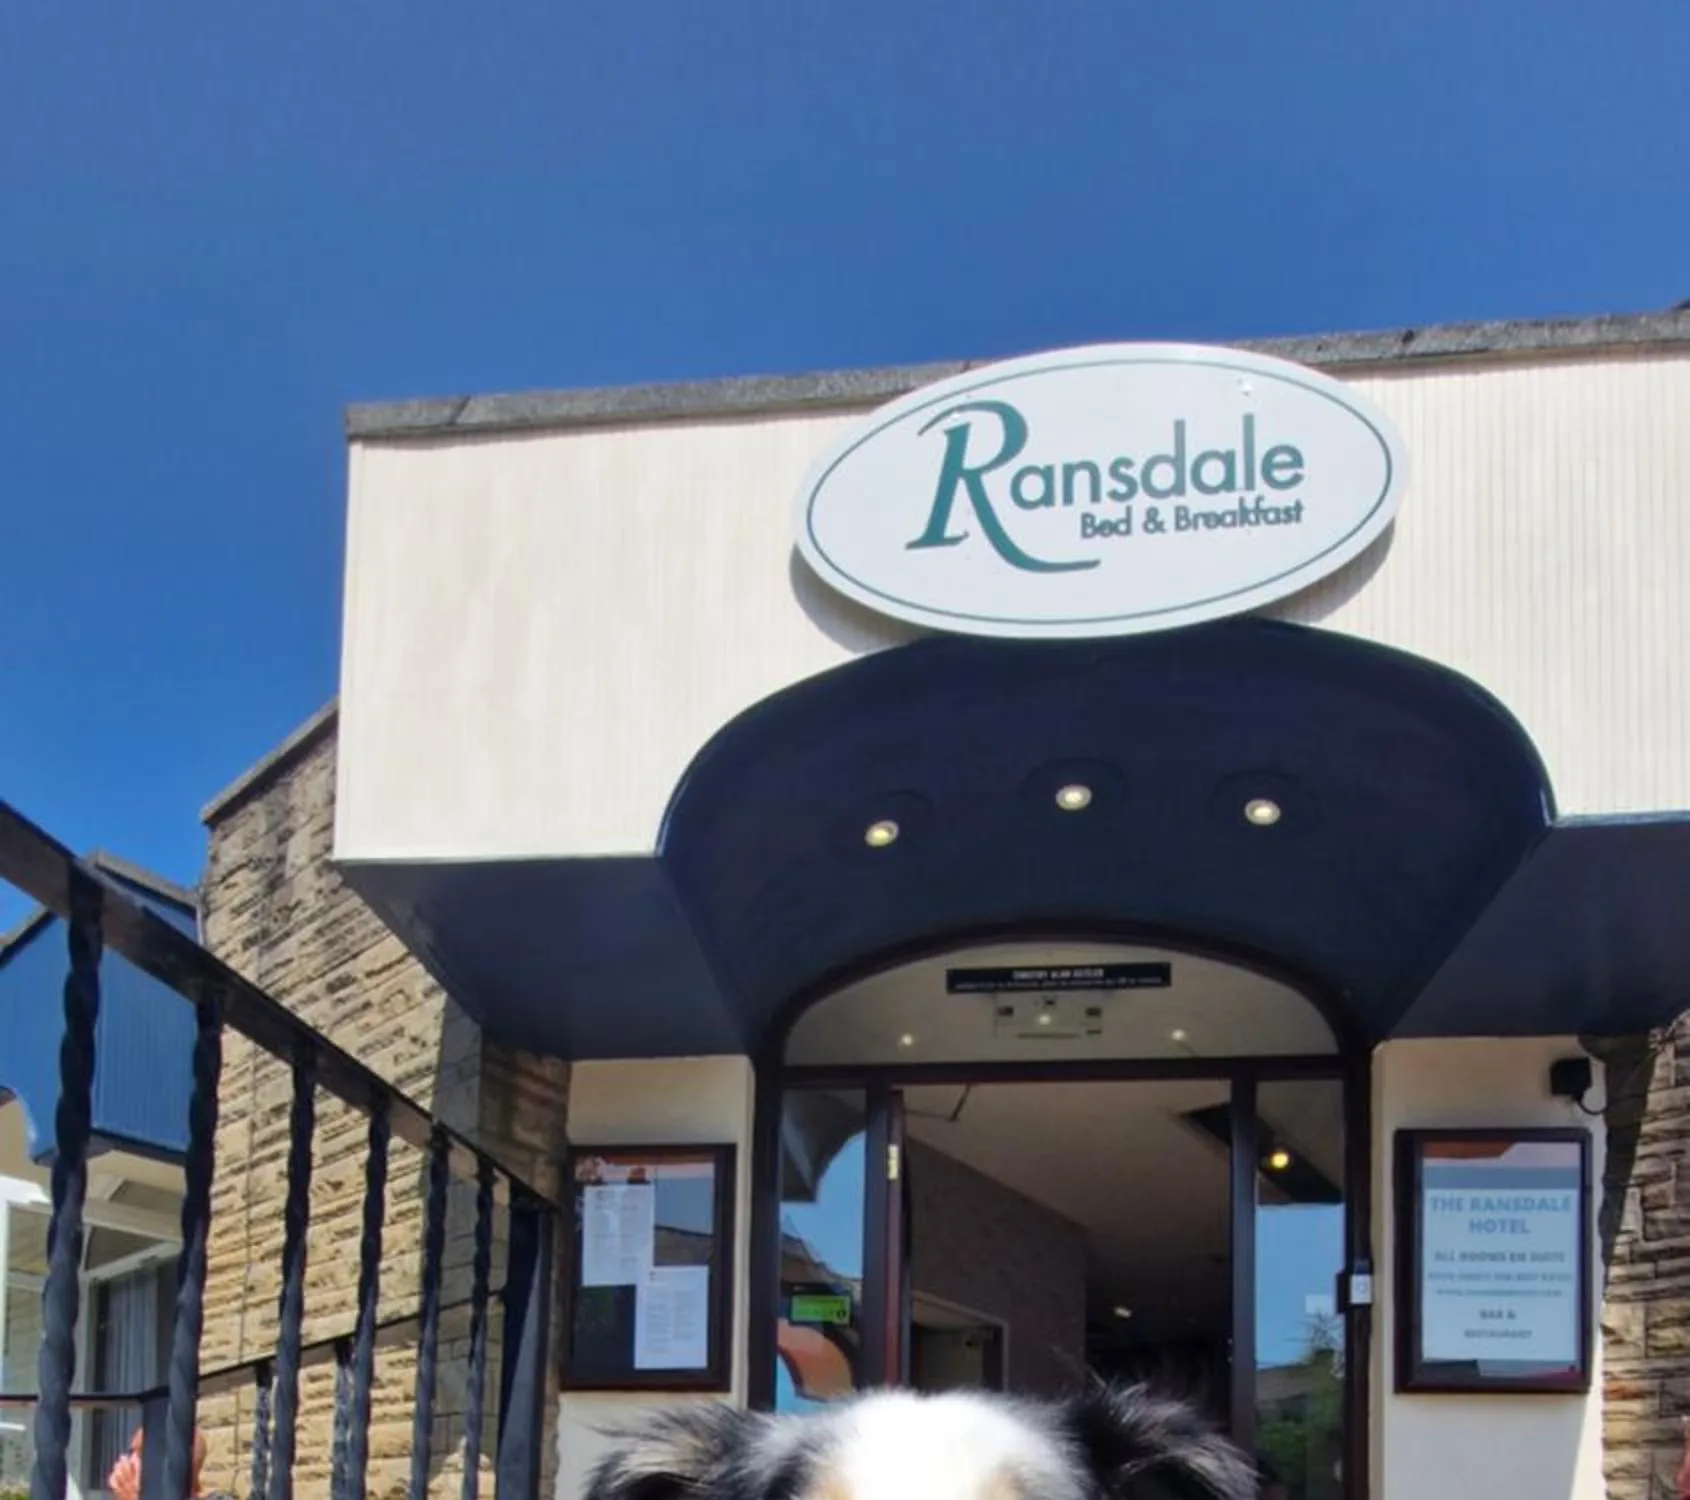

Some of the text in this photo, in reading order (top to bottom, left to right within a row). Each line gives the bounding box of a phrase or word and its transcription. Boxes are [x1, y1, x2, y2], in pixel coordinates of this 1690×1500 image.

[905, 400, 1304, 572] Ransdale
[1080, 495, 1304, 539] Bed & Breakfast
[1430, 1196, 1572, 1213] THE RANSDALE
[1469, 1217, 1532, 1235] HOTEL
